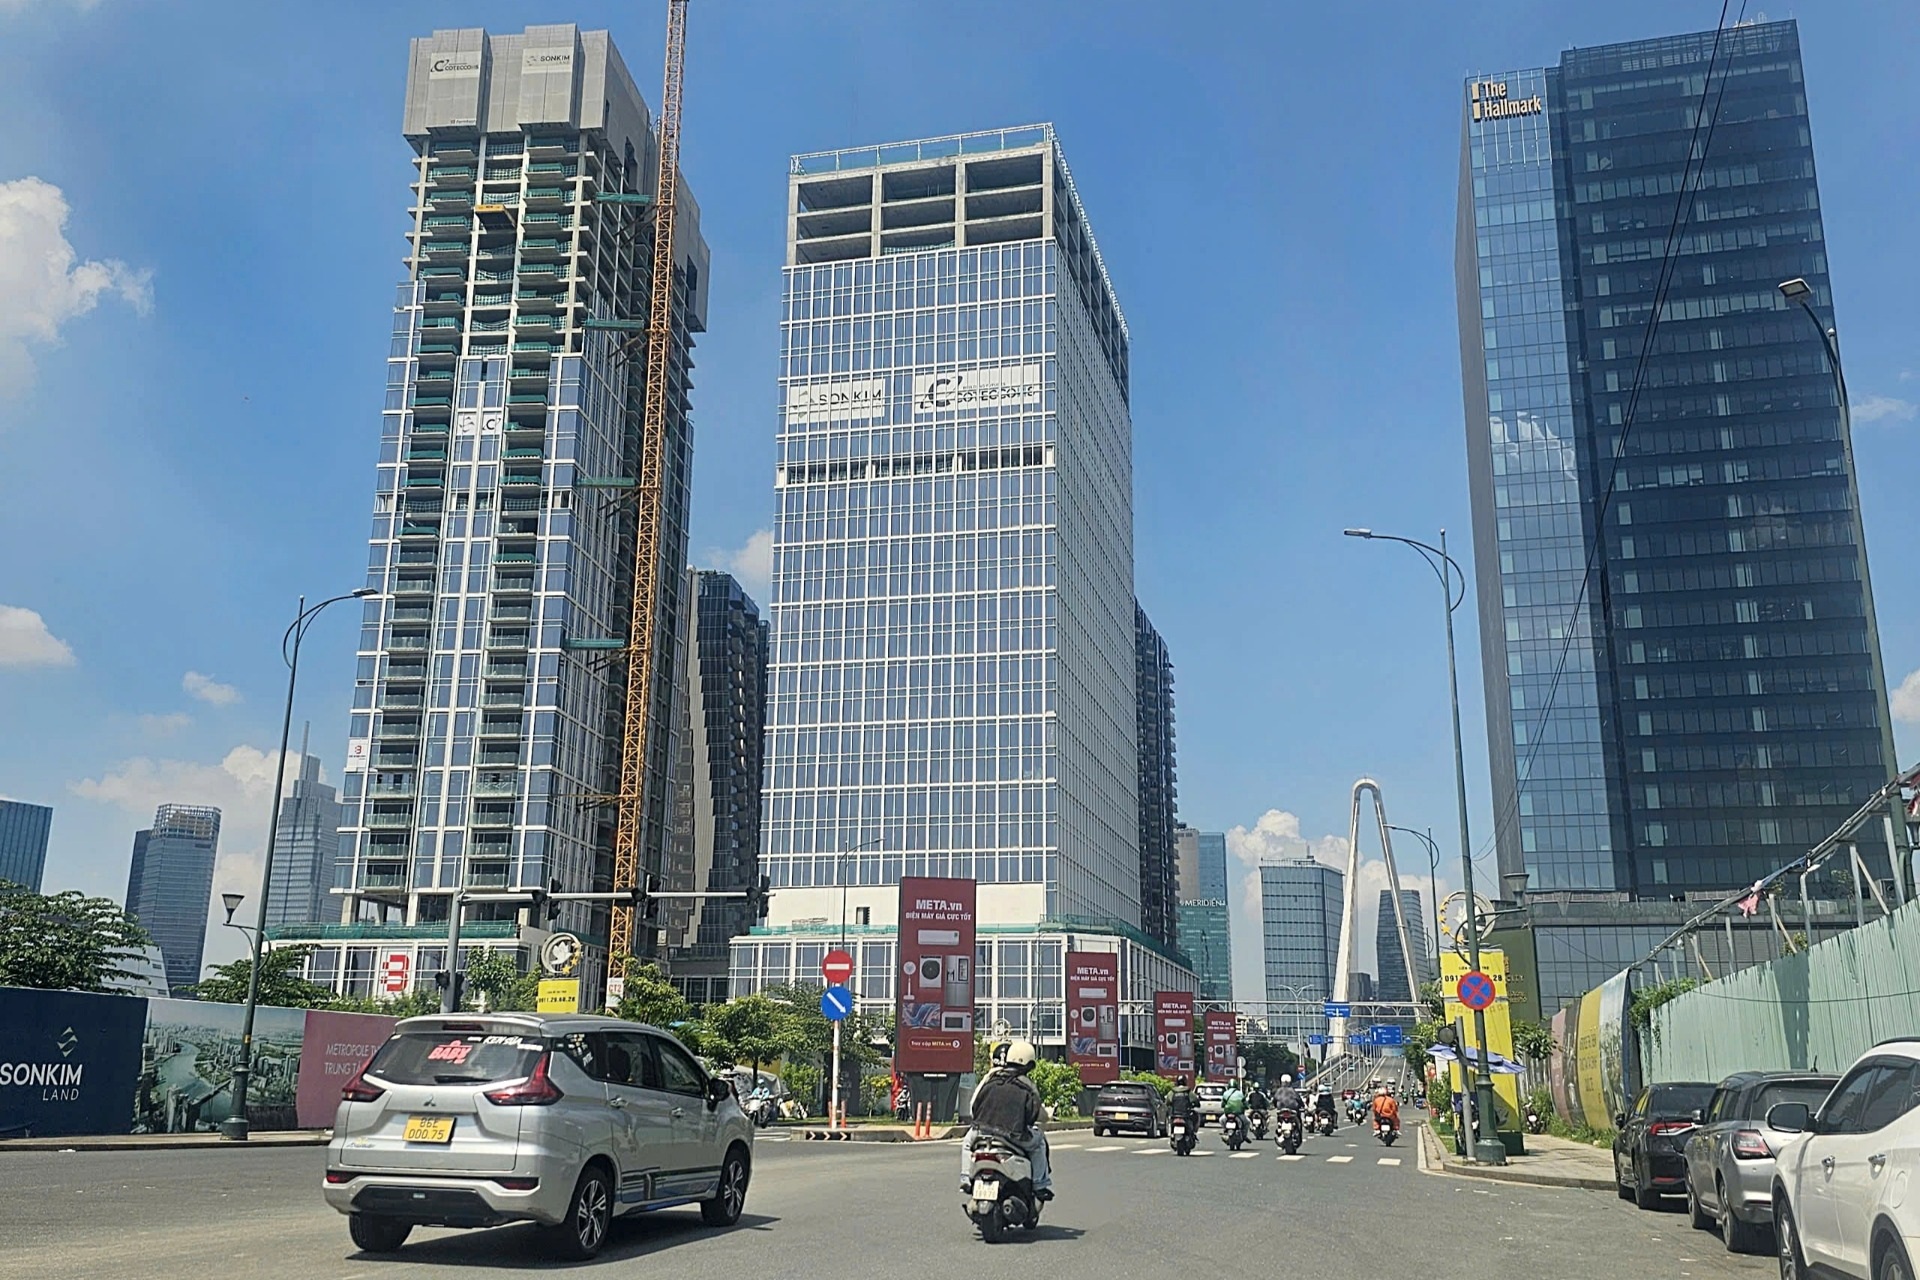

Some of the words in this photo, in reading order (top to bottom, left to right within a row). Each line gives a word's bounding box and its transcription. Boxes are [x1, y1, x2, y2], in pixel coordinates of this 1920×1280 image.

[540, 54, 570, 62] SONKIM
[1483, 80, 1507, 98] The
[1484, 94, 1542, 117] Hallmark
[819, 389, 882, 406] SONKIM
[916, 899, 962, 911] META.vn
[921, 911, 934, 920] MÁY
[935, 911, 946, 920] GIÁ
[947, 912, 960, 922] CỰC
[960, 912, 972, 921] TỐT
[1076, 966, 1109, 975] META.vn
[608, 984, 622, 993] CT2
[325, 1043, 369, 1057] METROPOLE
[0, 1062, 83, 1086] SONKIM
[324, 1062, 351, 1075] TRUNG
[42, 1088, 79, 1101] LAND
[408, 1128, 445, 1140] 000.75
